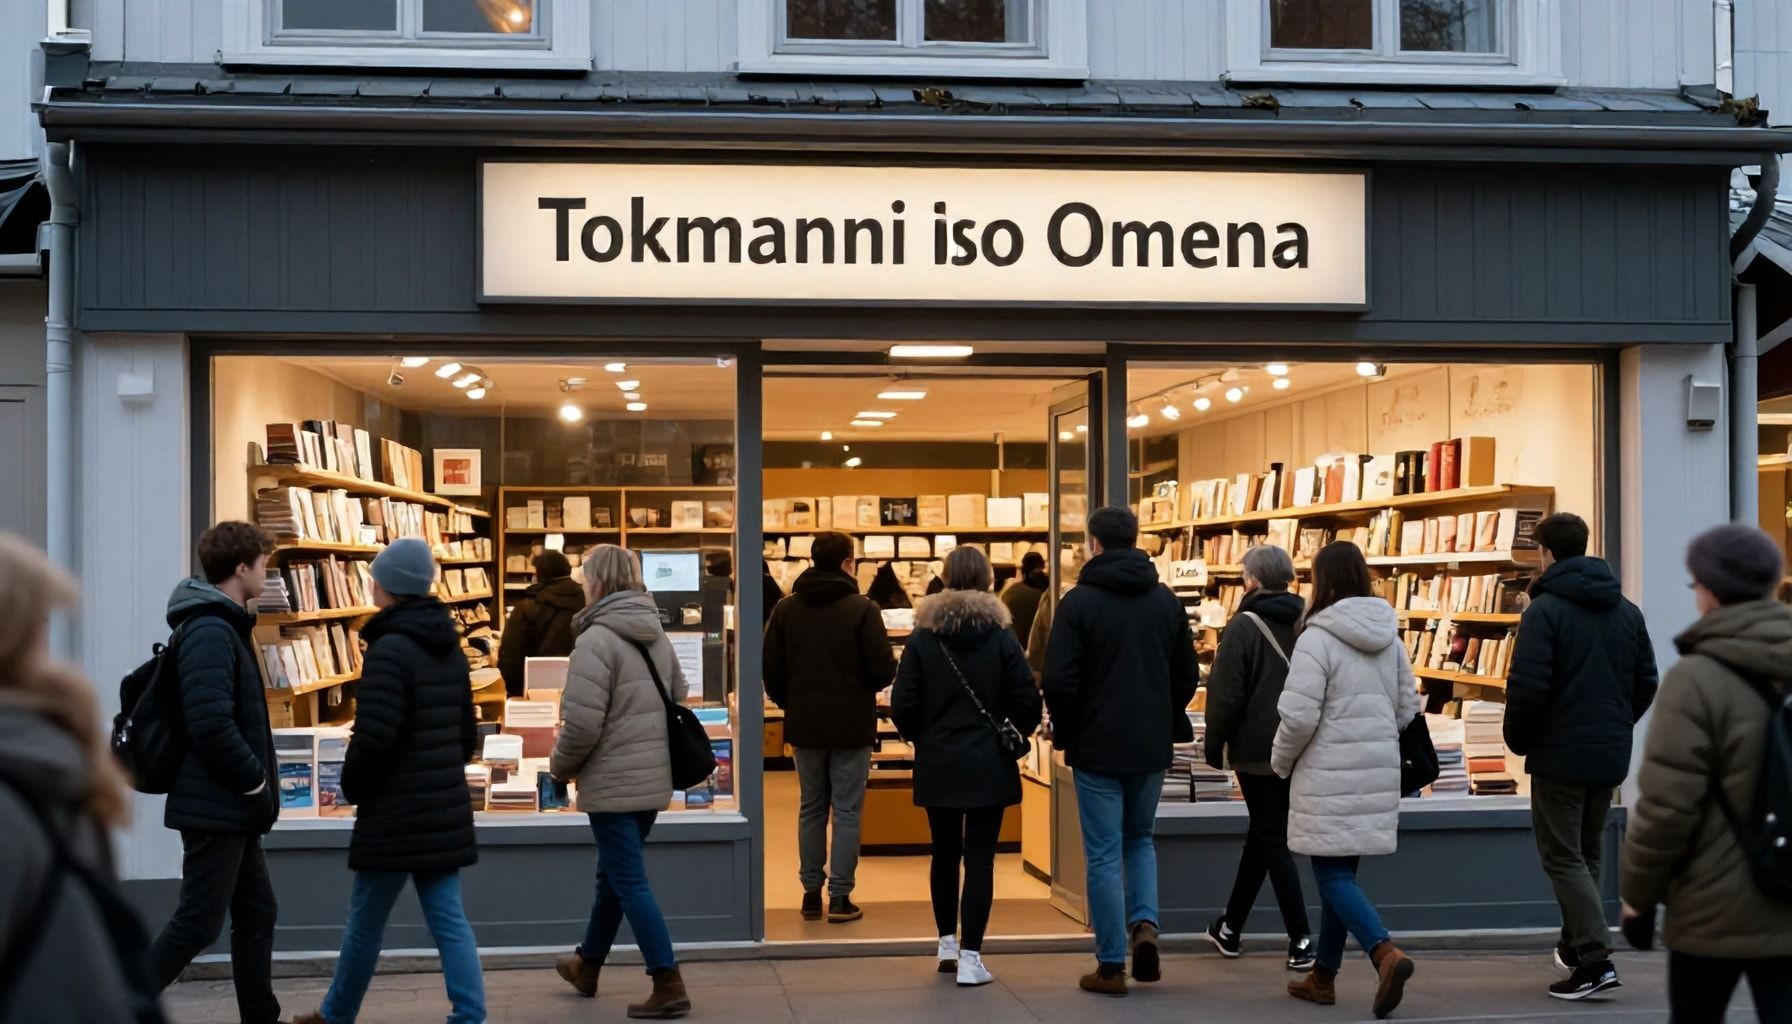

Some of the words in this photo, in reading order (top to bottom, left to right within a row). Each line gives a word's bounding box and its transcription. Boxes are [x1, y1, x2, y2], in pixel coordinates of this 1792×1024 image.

[537, 196, 906, 265] Tokmanni
[933, 201, 1024, 267] iso
[1047, 202, 1309, 269] Omena
